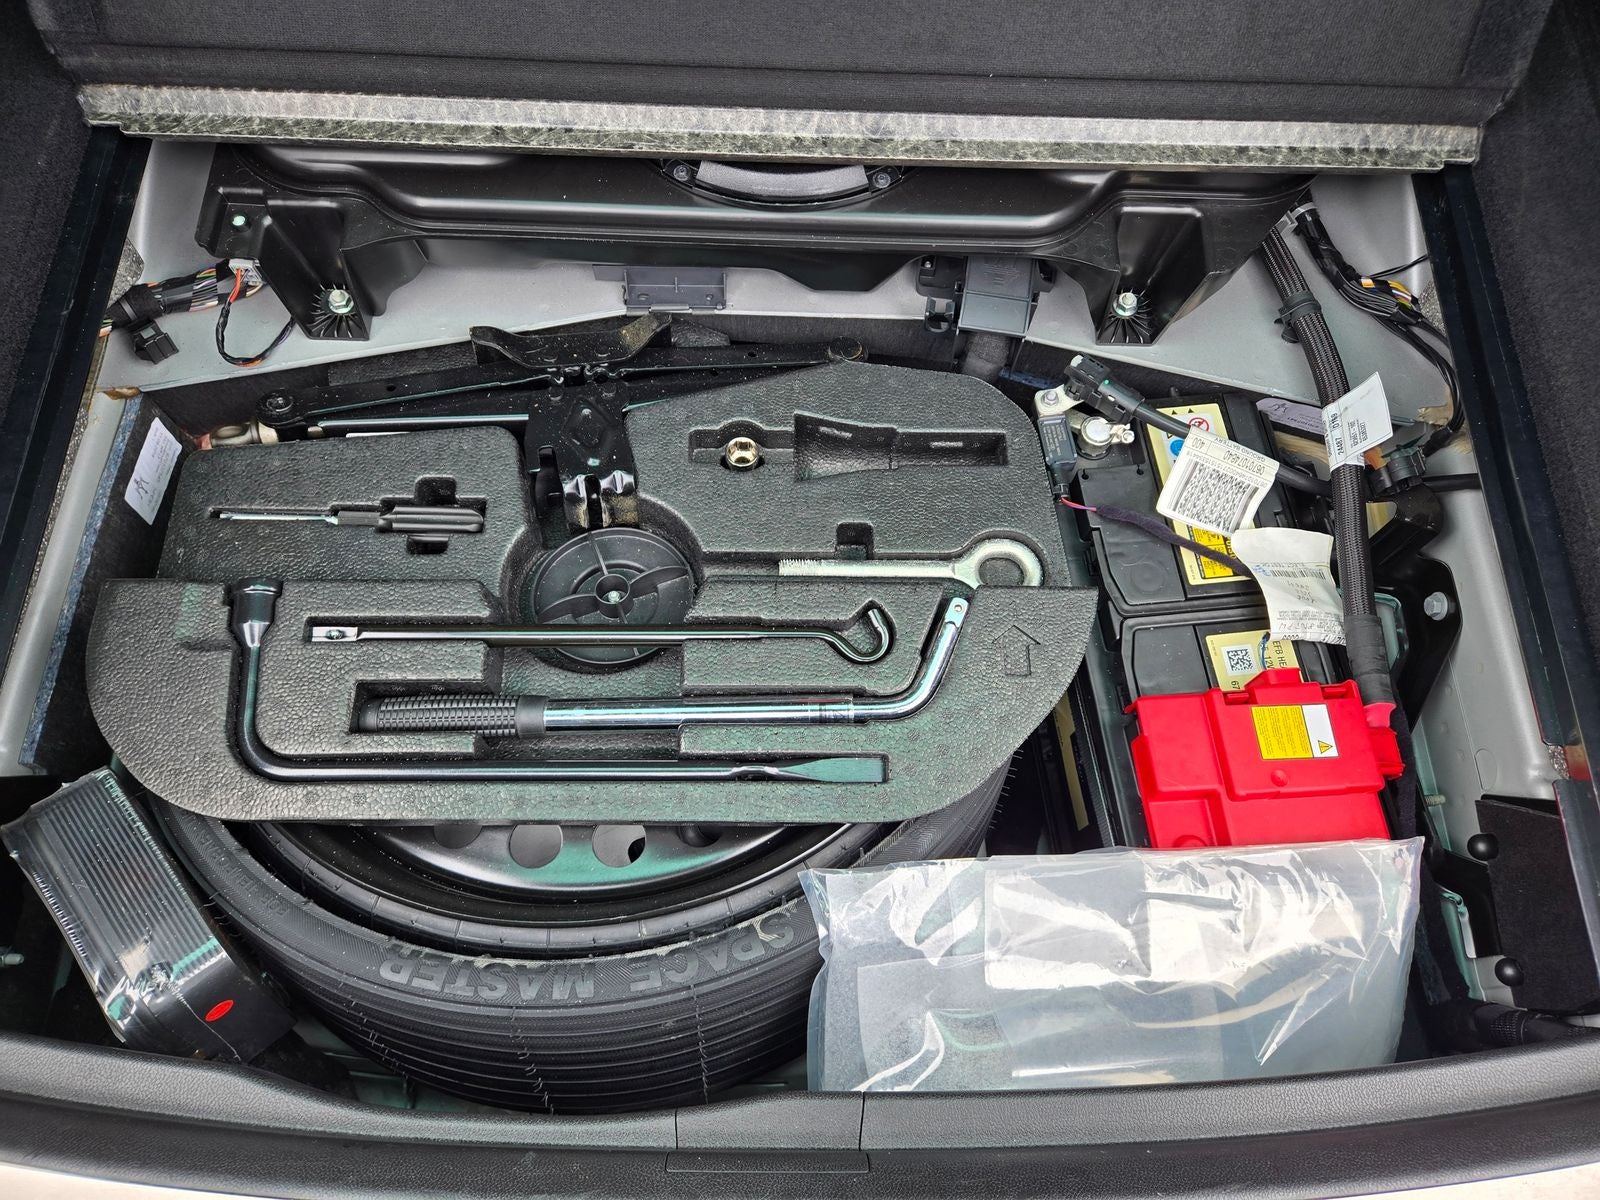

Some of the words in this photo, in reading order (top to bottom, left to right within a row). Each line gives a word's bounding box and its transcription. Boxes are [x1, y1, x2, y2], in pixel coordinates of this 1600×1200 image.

[1272, 640, 1283, 655] EFB
[379, 942, 595, 999] MASTER
[630, 911, 796, 990] SPACE
